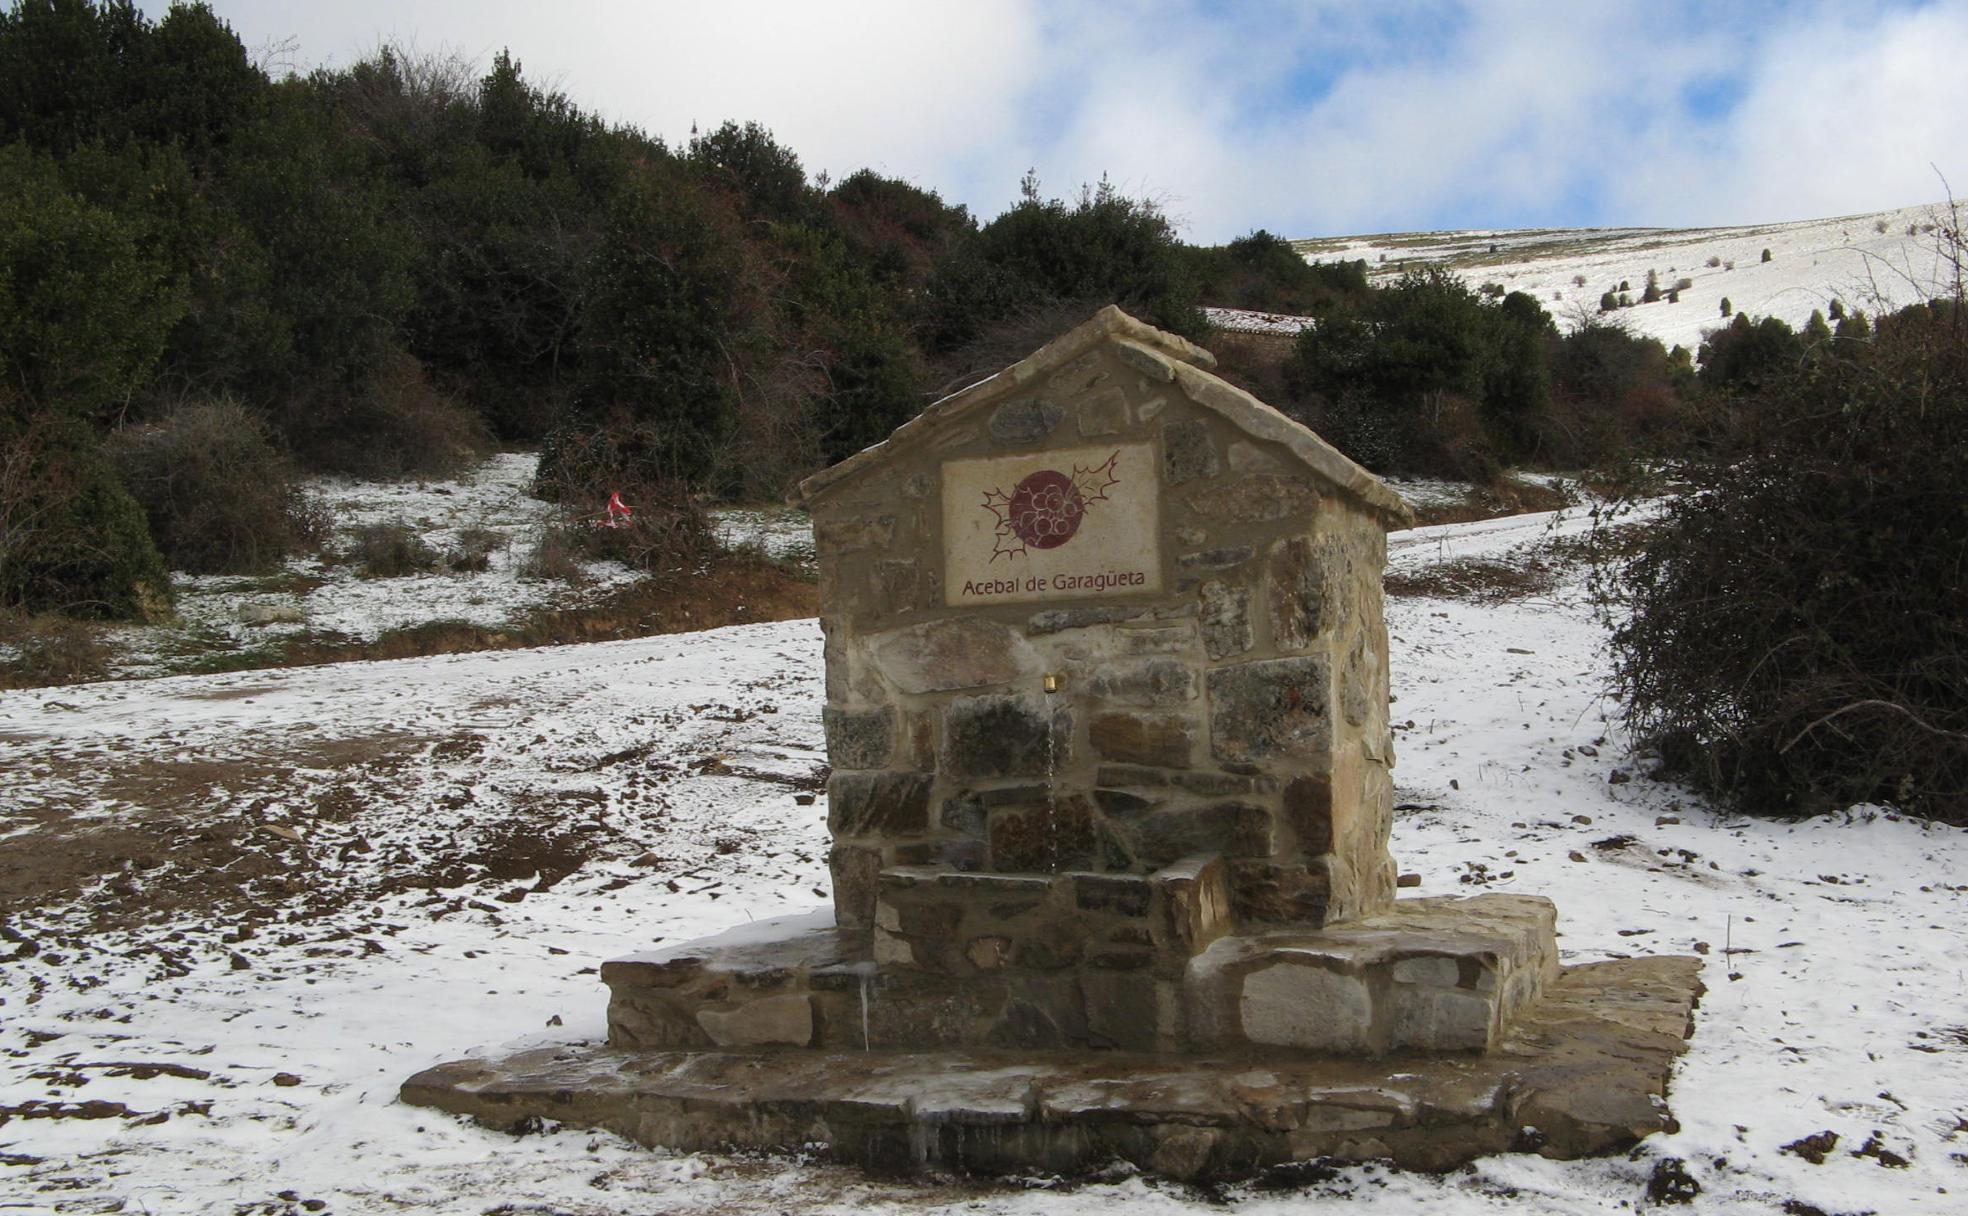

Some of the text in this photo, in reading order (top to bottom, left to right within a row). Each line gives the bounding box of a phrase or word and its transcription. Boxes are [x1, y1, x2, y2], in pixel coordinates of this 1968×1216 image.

[962, 571, 1145, 595] Acebal de Garagüeta
